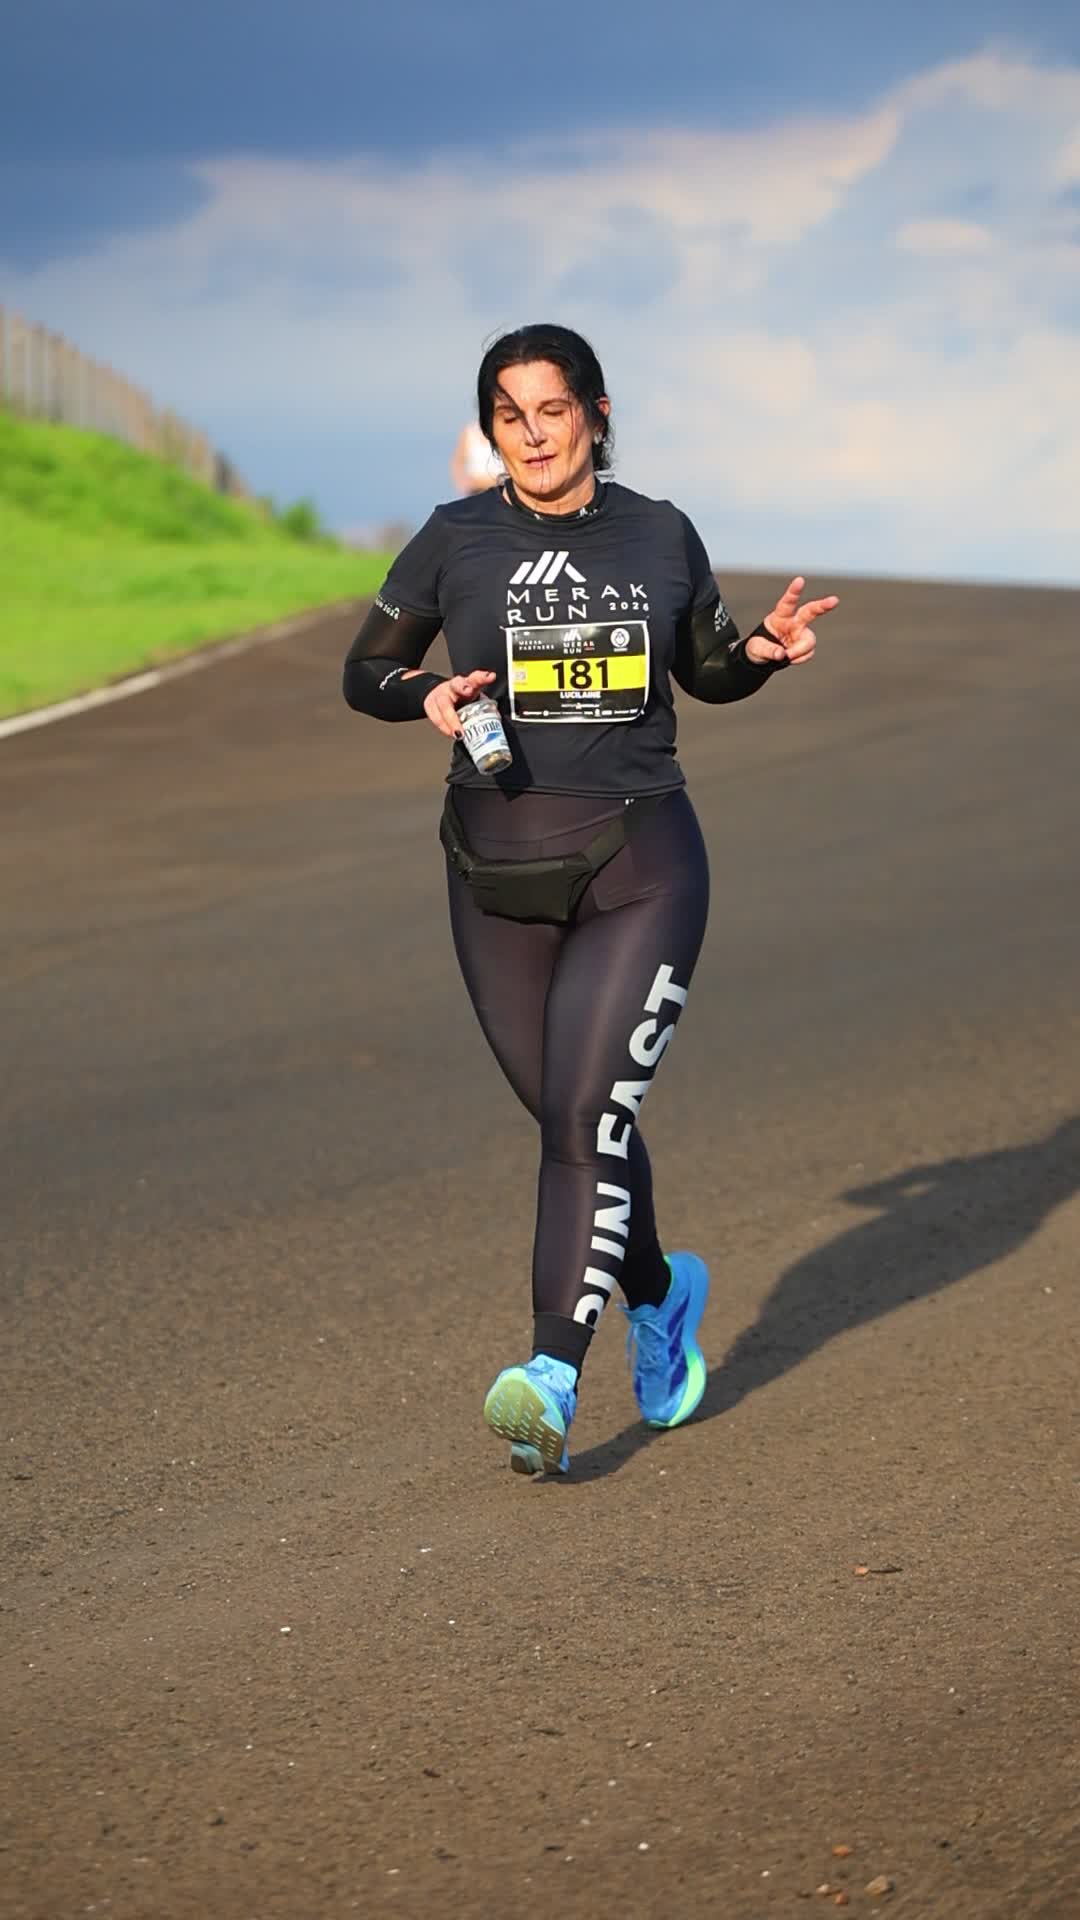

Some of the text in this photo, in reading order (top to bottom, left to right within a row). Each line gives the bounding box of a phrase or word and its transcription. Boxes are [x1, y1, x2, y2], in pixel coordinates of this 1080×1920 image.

[507, 583, 648, 606] MERAK
[506, 602, 650, 625] RUN 2026
[552, 658, 609, 690] 181
[559, 690, 601, 699] LUCILAINE
